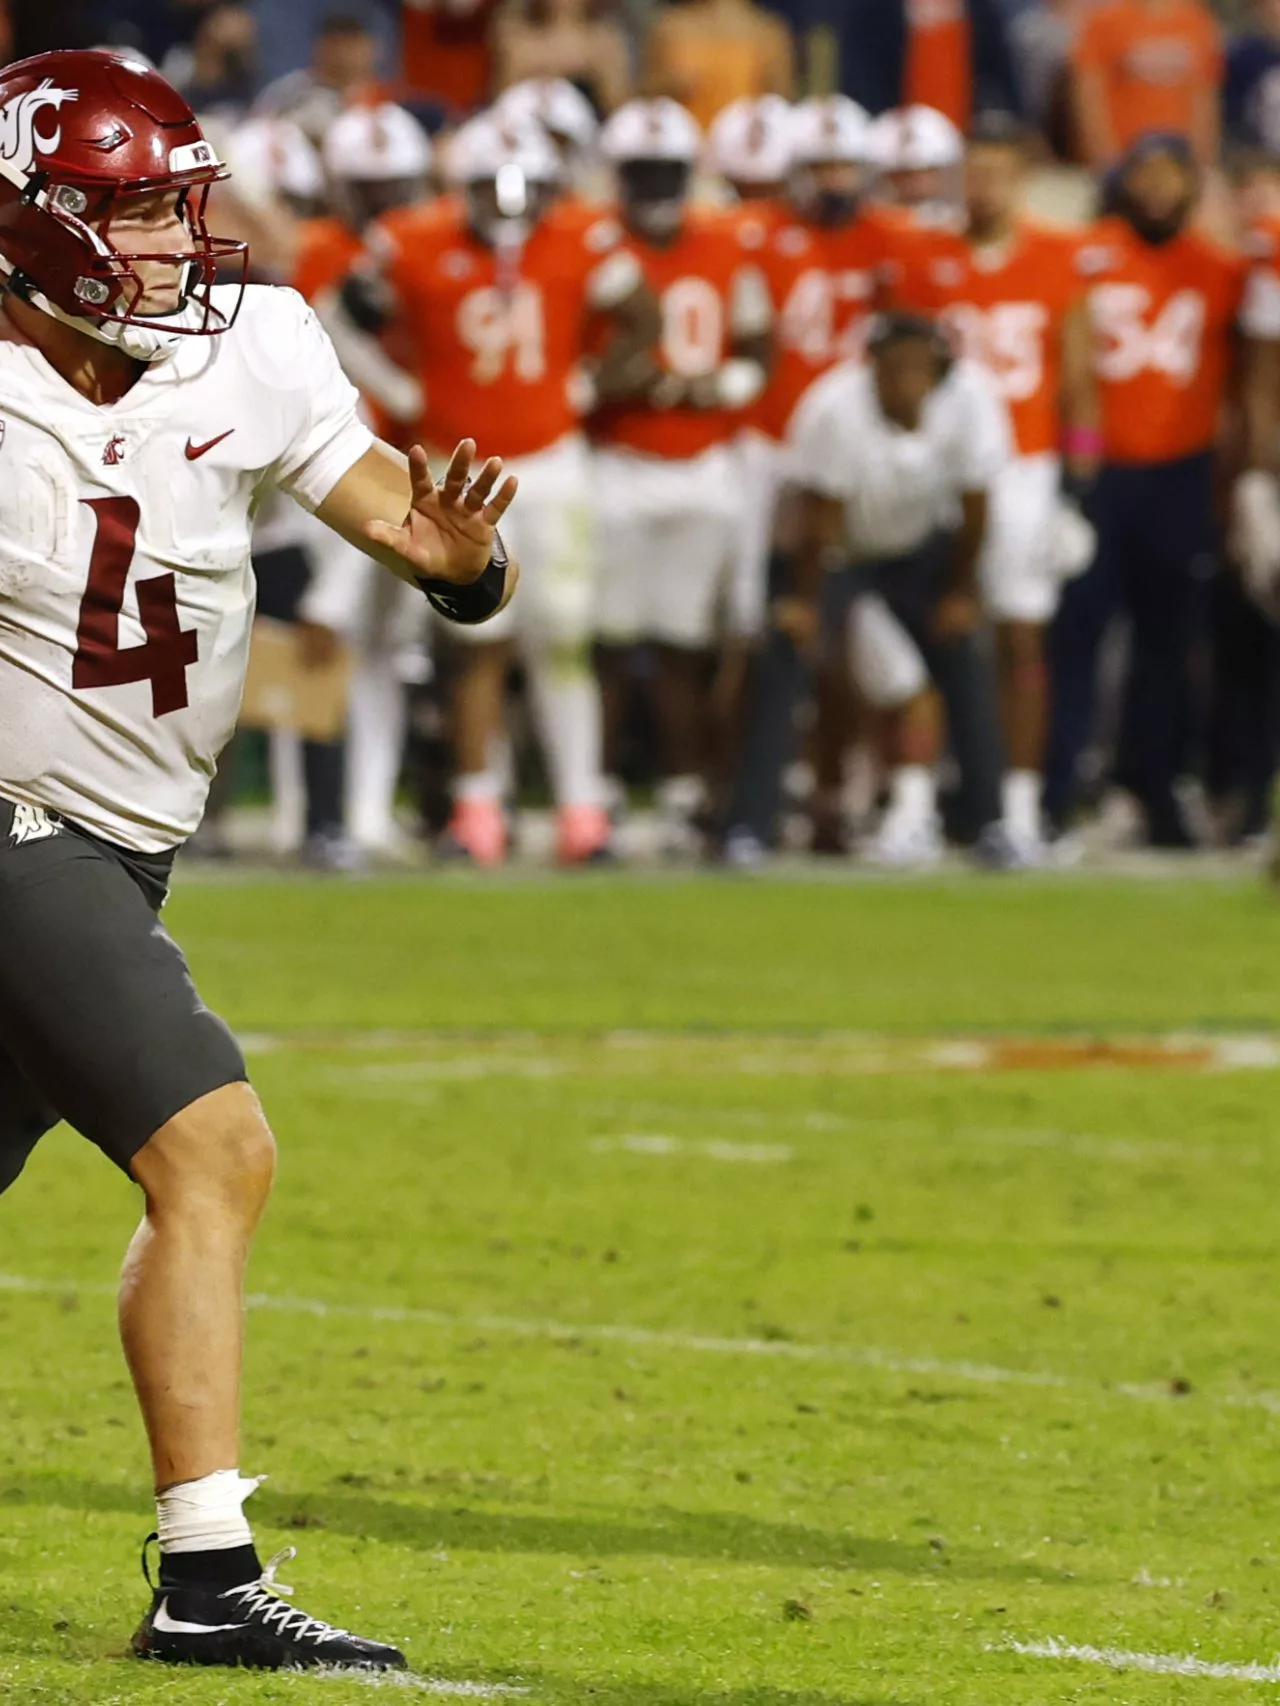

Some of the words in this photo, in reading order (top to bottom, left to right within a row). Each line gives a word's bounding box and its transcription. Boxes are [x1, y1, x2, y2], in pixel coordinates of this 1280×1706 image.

[457, 281, 546, 383] 91
[662, 277, 721, 377] 0
[1088, 283, 1206, 388] 54
[73, 494, 199, 719] 4
